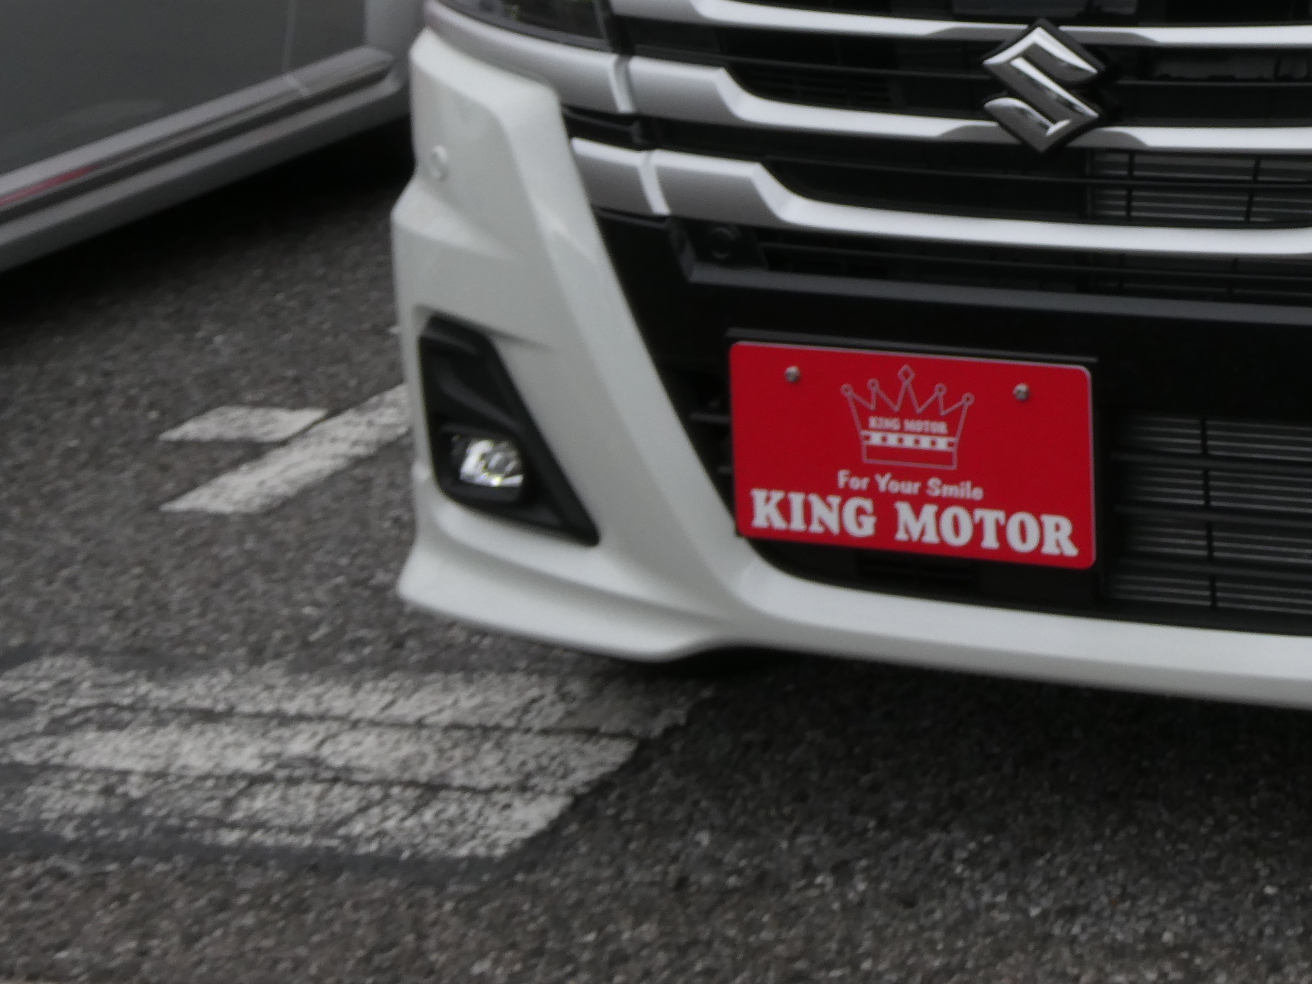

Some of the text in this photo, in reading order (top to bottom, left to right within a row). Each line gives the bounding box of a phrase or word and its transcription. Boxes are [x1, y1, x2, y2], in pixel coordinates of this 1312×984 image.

[869, 416, 948, 435] KING MOTOR
[837, 470, 984, 501] For Your Smile
[751, 489, 1079, 557] KING MOTOR
